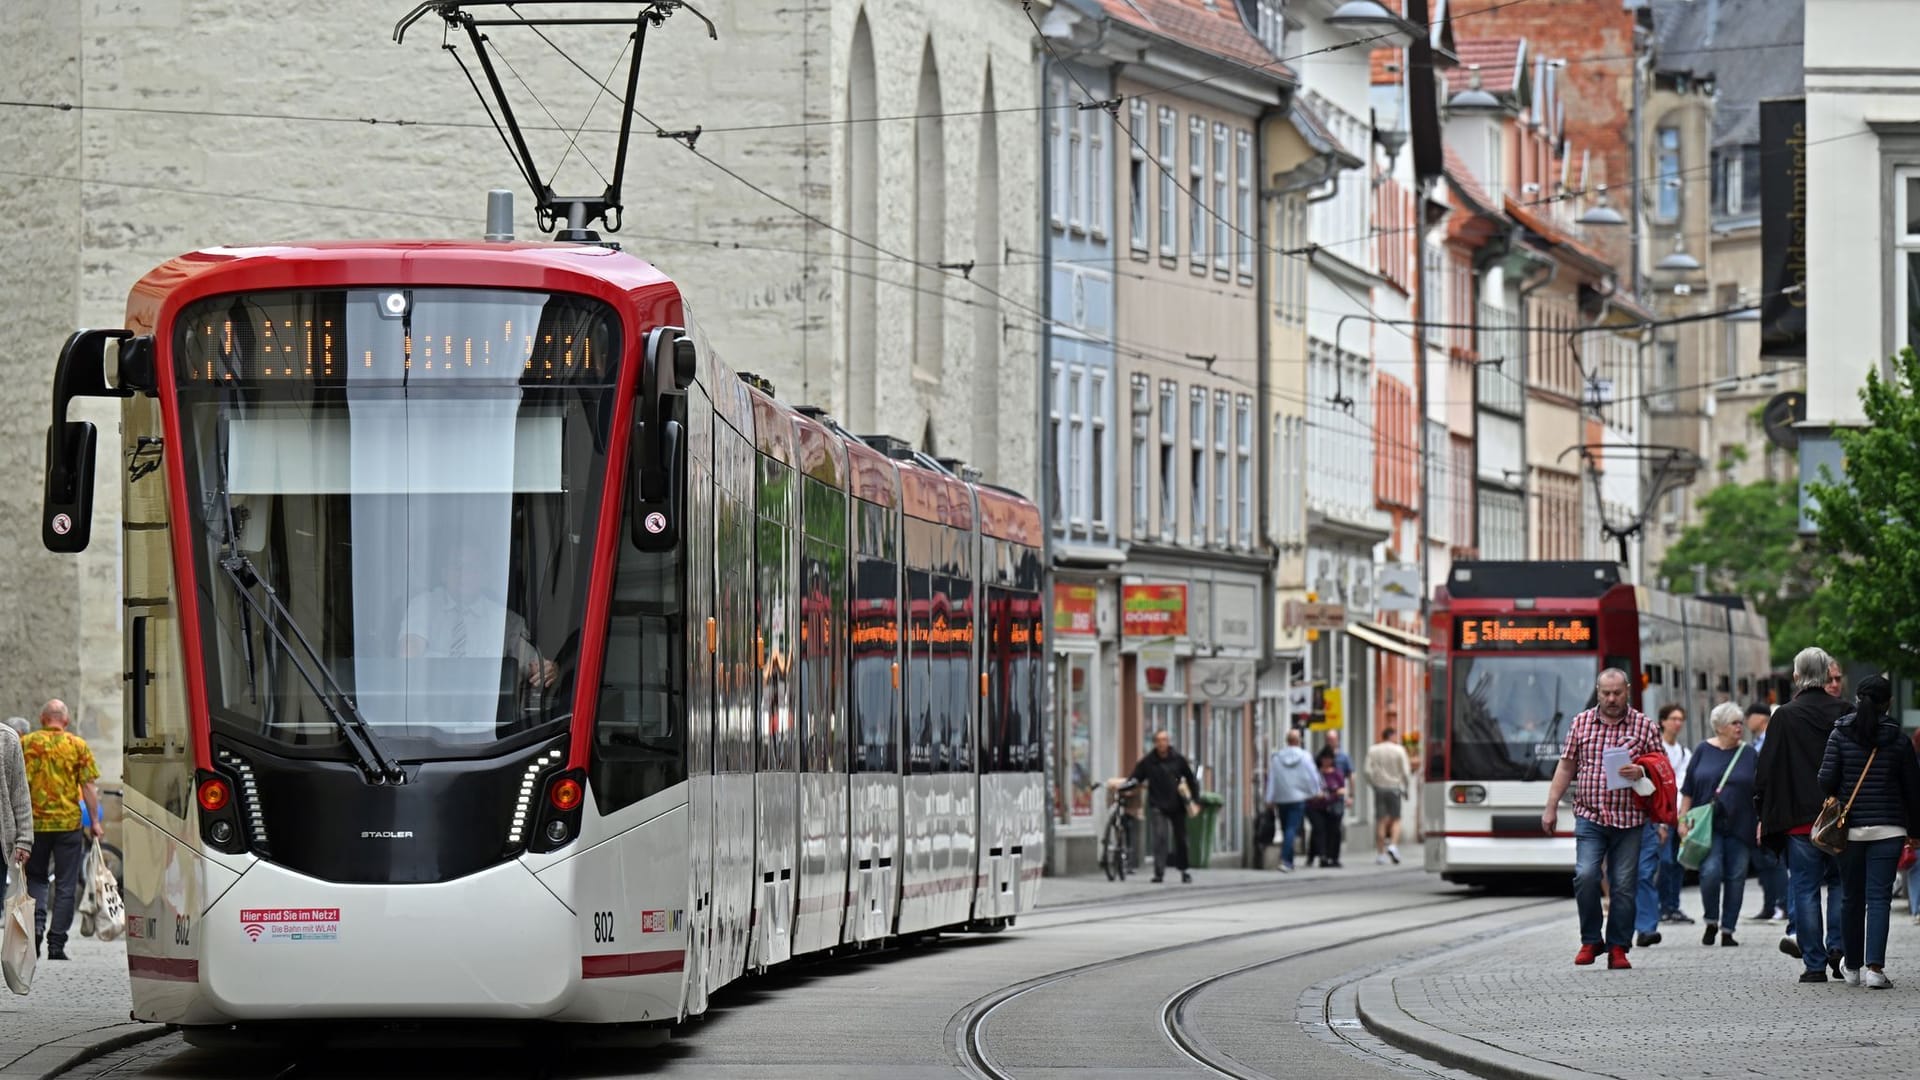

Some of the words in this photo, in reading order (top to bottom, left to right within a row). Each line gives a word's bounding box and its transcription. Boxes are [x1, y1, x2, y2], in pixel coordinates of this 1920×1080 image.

[1463, 621, 1477, 644] 6
[242, 911, 261, 921] Hier
[263, 910, 281, 921] sind
[283, 910, 298, 920] Sie
[299, 910, 311, 920] im
[312, 909, 337, 920] Netz!
[271, 925, 283, 933] Die
[284, 924, 302, 933] Bahn
[303, 924, 315, 932] mit
[315, 924, 337, 932] WLAN
[594, 911, 614, 942] 802
